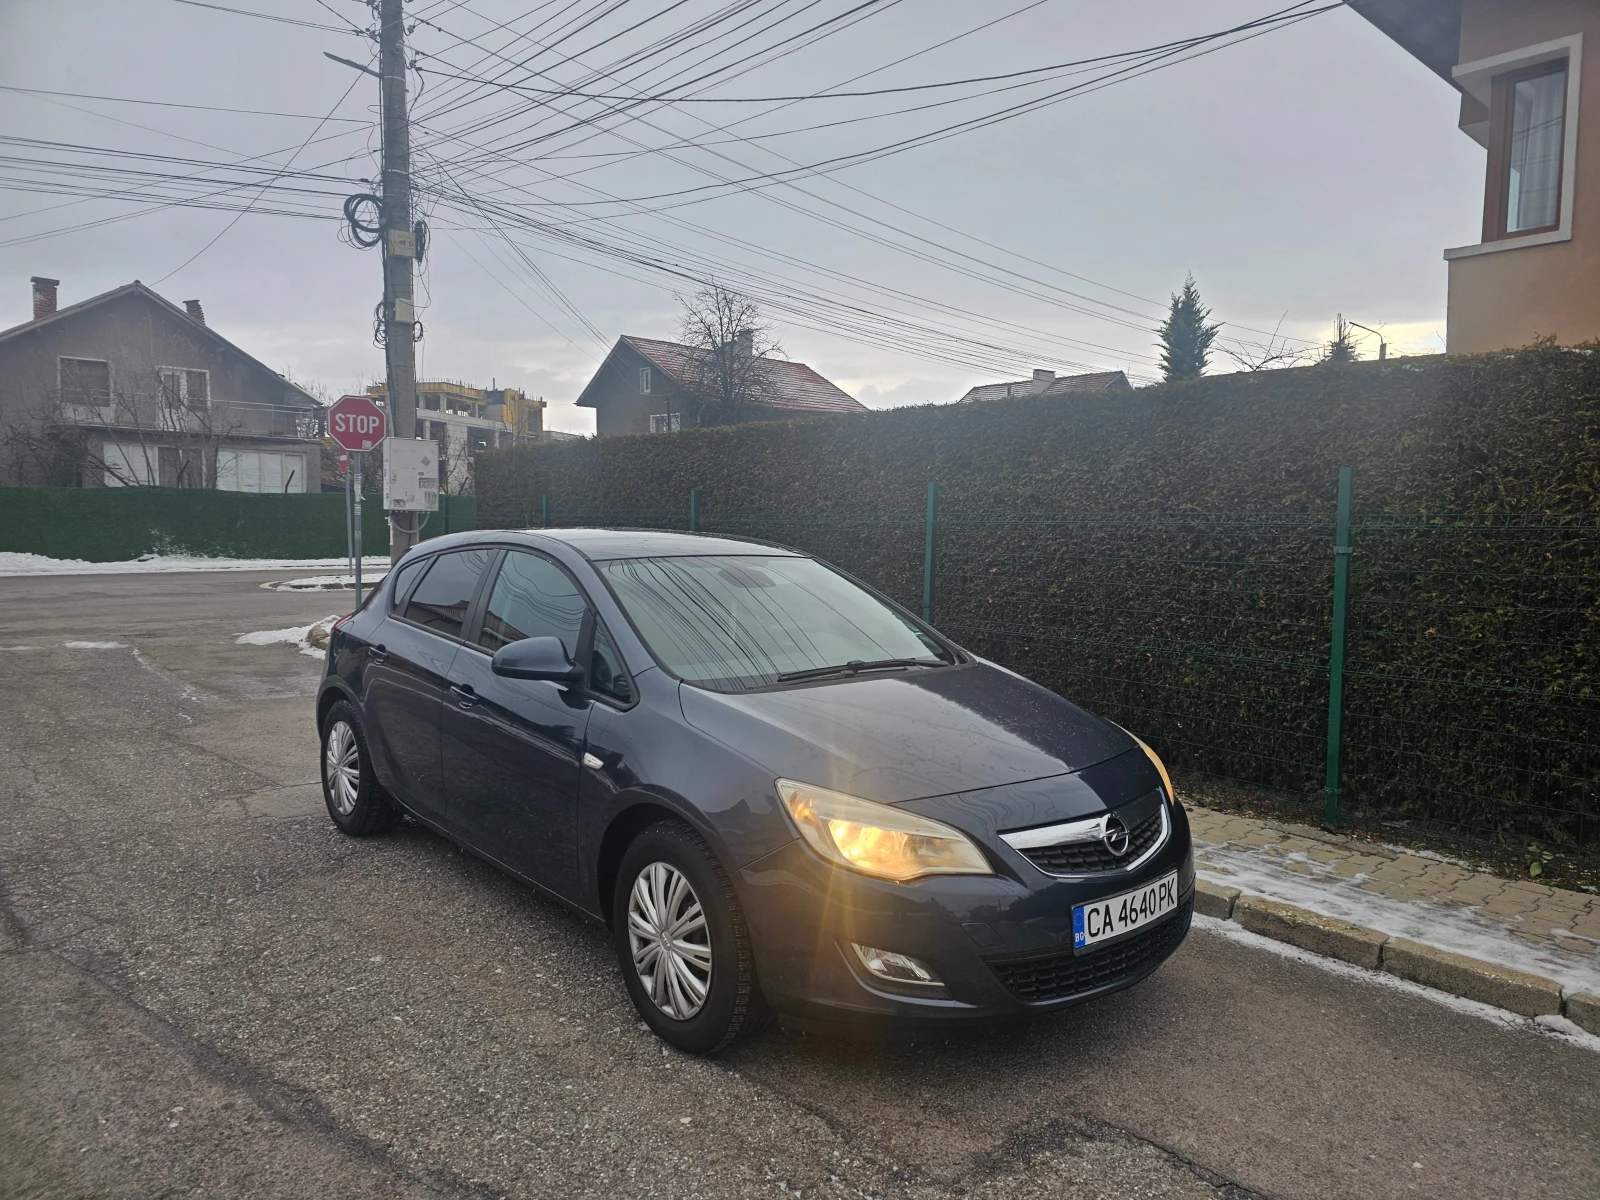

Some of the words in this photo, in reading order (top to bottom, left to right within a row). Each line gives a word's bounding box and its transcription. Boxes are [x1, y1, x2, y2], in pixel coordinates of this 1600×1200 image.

[335, 413, 380, 434] STOP
[1087, 904, 1114, 938] CA
[1118, 888, 1156, 927] 4640
[1159, 877, 1175, 912] PK
[1074, 931, 1086, 943] BG
